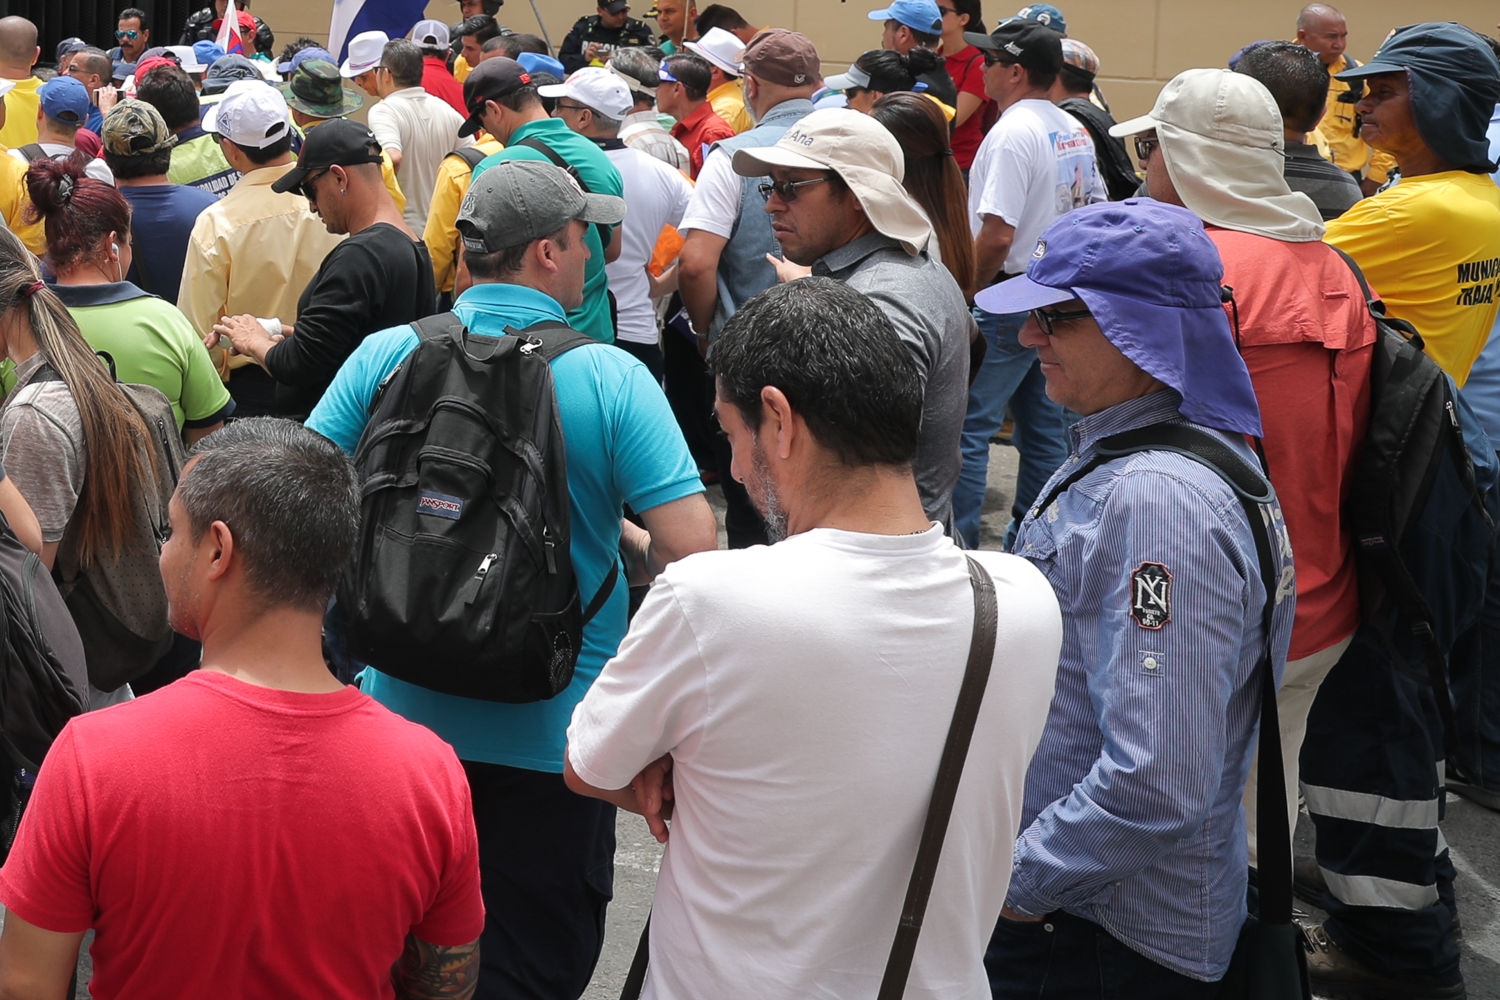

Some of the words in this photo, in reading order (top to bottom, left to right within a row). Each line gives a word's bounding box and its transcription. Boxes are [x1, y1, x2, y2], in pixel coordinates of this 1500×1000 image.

[790, 129, 814, 147] Ana
[196, 176, 228, 193] PALIDAD
[419, 496, 460, 511] JANSPORT
